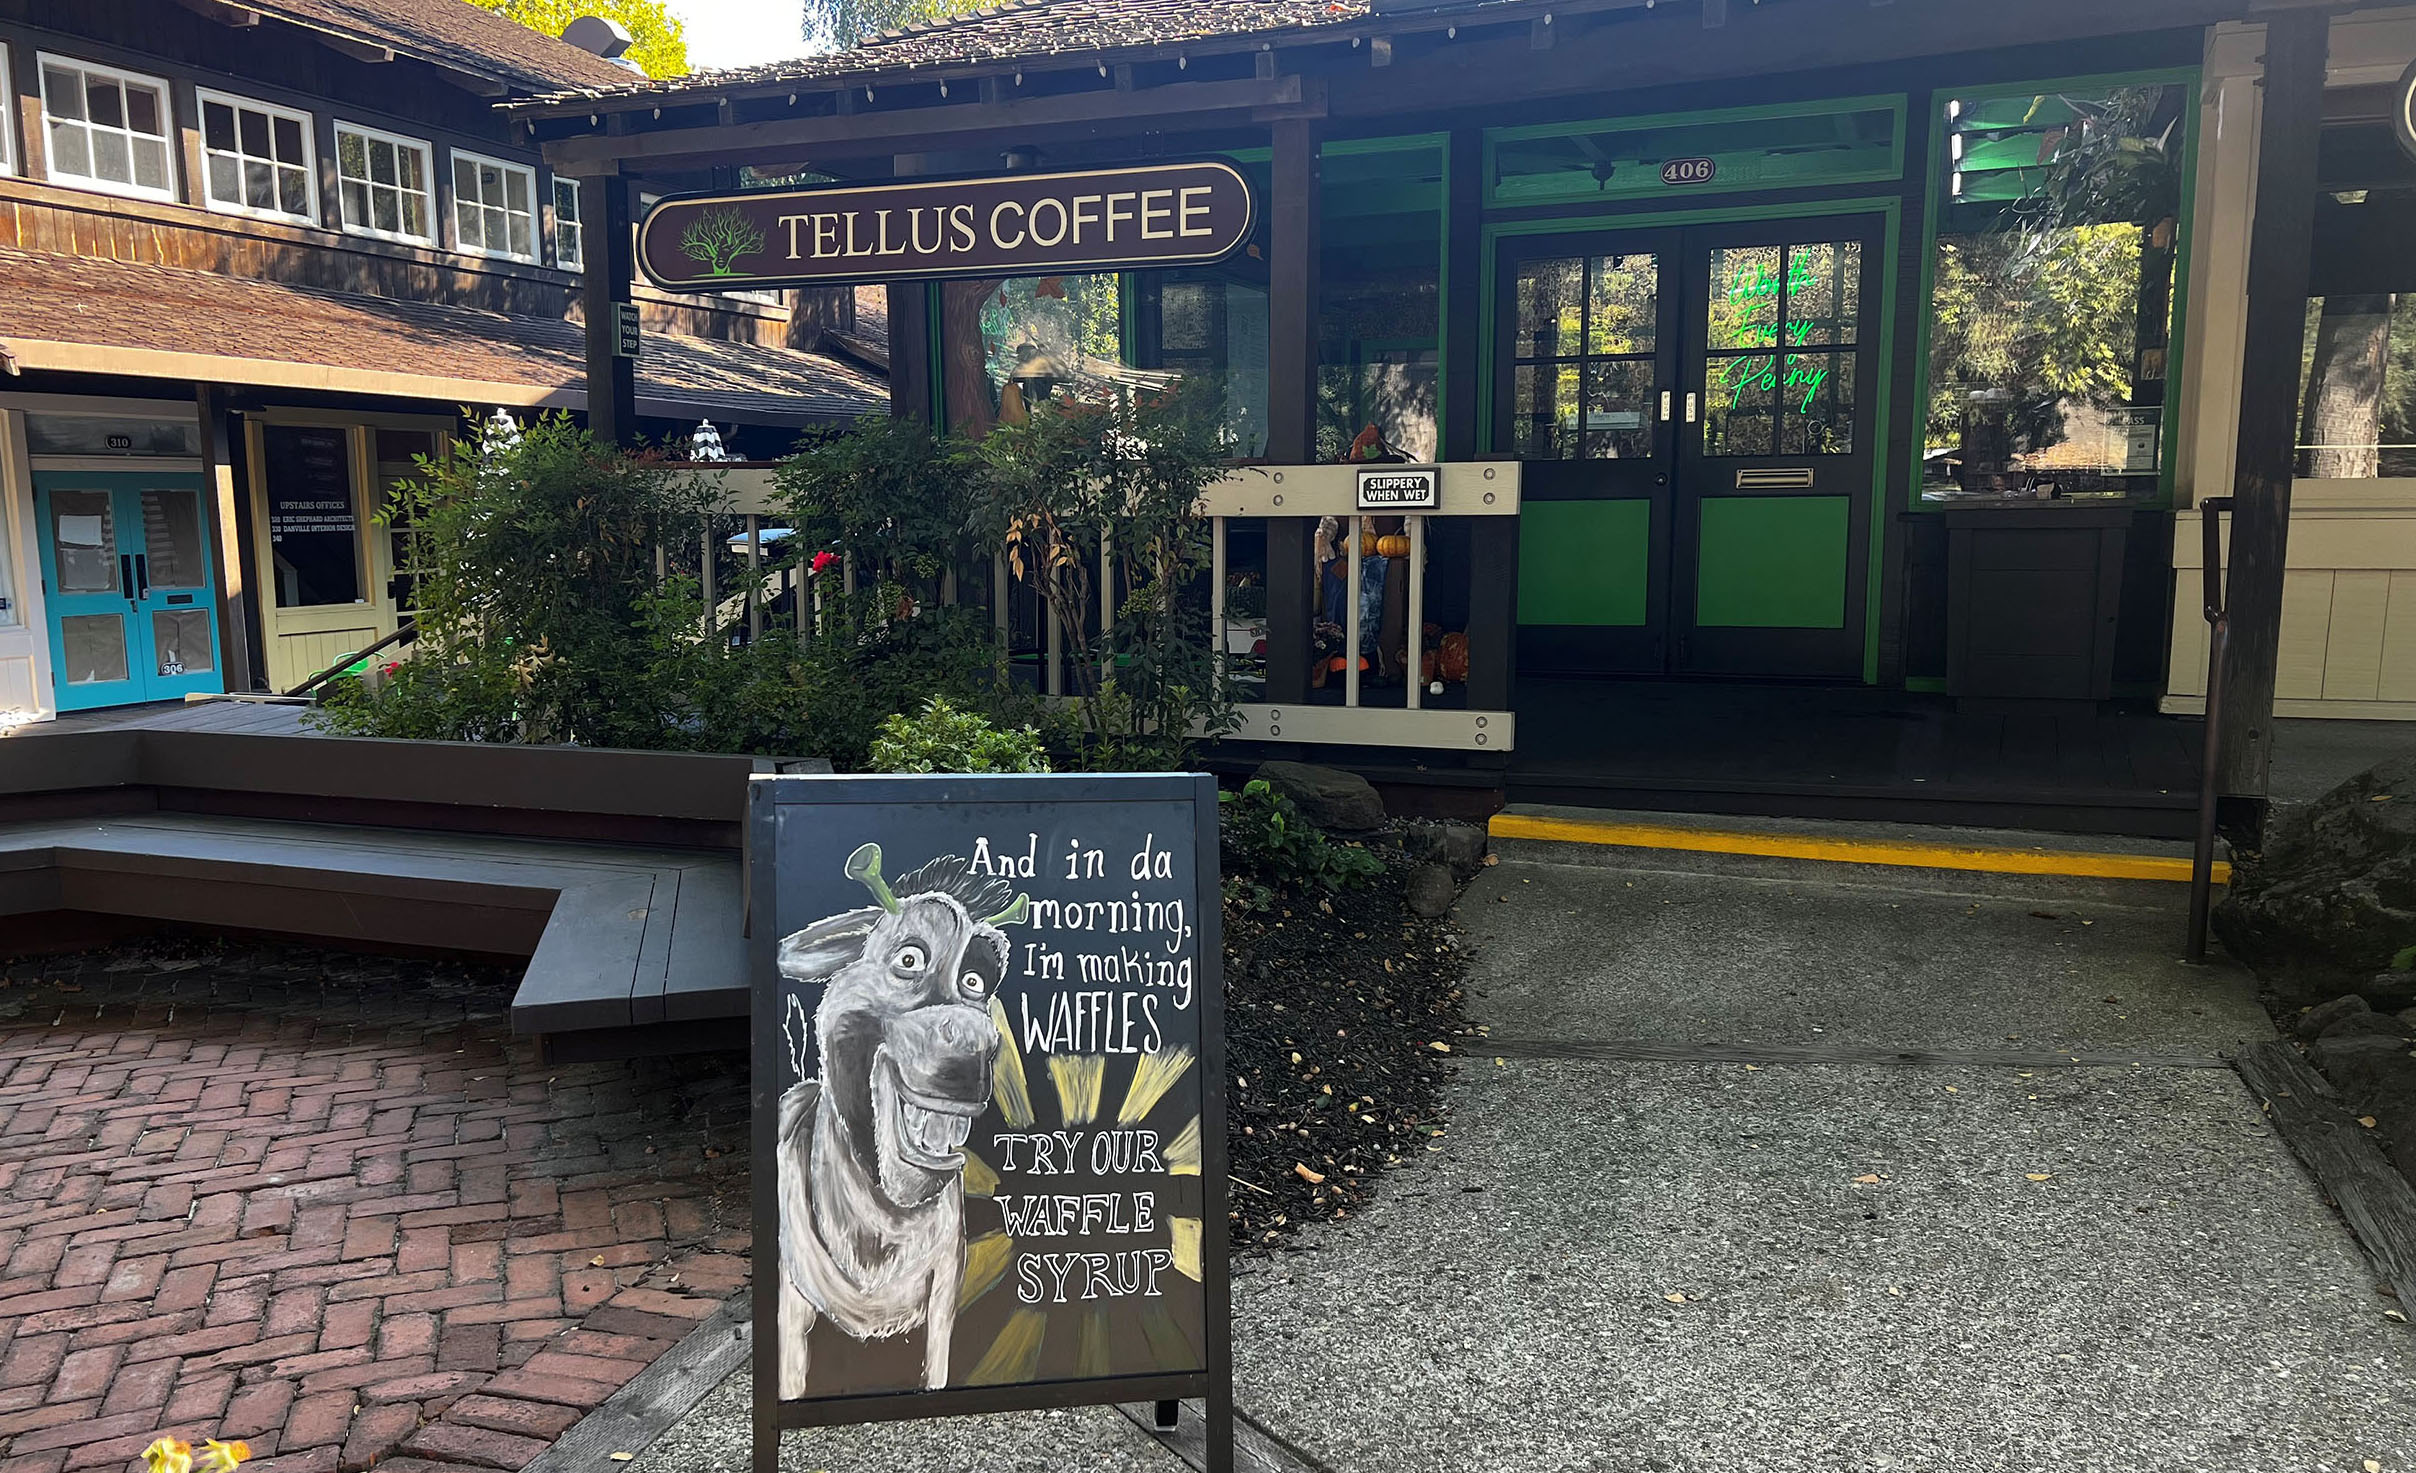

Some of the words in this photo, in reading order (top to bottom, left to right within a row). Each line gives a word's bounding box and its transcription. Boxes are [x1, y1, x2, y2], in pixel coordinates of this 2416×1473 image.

[1663, 160, 1710, 180] 406
[777, 203, 977, 260] TELLUS
[989, 185, 1213, 251] COFFEE
[620, 311, 638, 322] WATCH
[621, 324, 639, 336] YOUR
[1727, 302, 1815, 365] Every
[622, 338, 638, 349] STEP
[110, 437, 129, 448] 310
[1369, 478, 1423, 490] SLIPPERY
[1366, 489, 1399, 501] WHEN
[1403, 489, 1427, 501] WET
[280, 501, 315, 510] UPSTAIRS
[316, 501, 345, 510] OFFICES
[311, 524, 336, 532] INTERIOR
[162, 663, 184, 675] 306
[966, 832, 1039, 879] And
[1065, 838, 1105, 880] in
[1130, 832, 1173, 881] da
[1028, 890, 1193, 955] morning,
[1023, 941, 1065, 981] I'm
[1076, 944, 1193, 1011] making
[1020, 990, 1163, 1055] WAFFLES
[993, 1130, 1085, 1176] TRY
[1090, 1129, 1165, 1176] OUR
[992, 1191, 1155, 1238] WAFFLE
[1016, 1248, 1174, 1304] SYRUP
